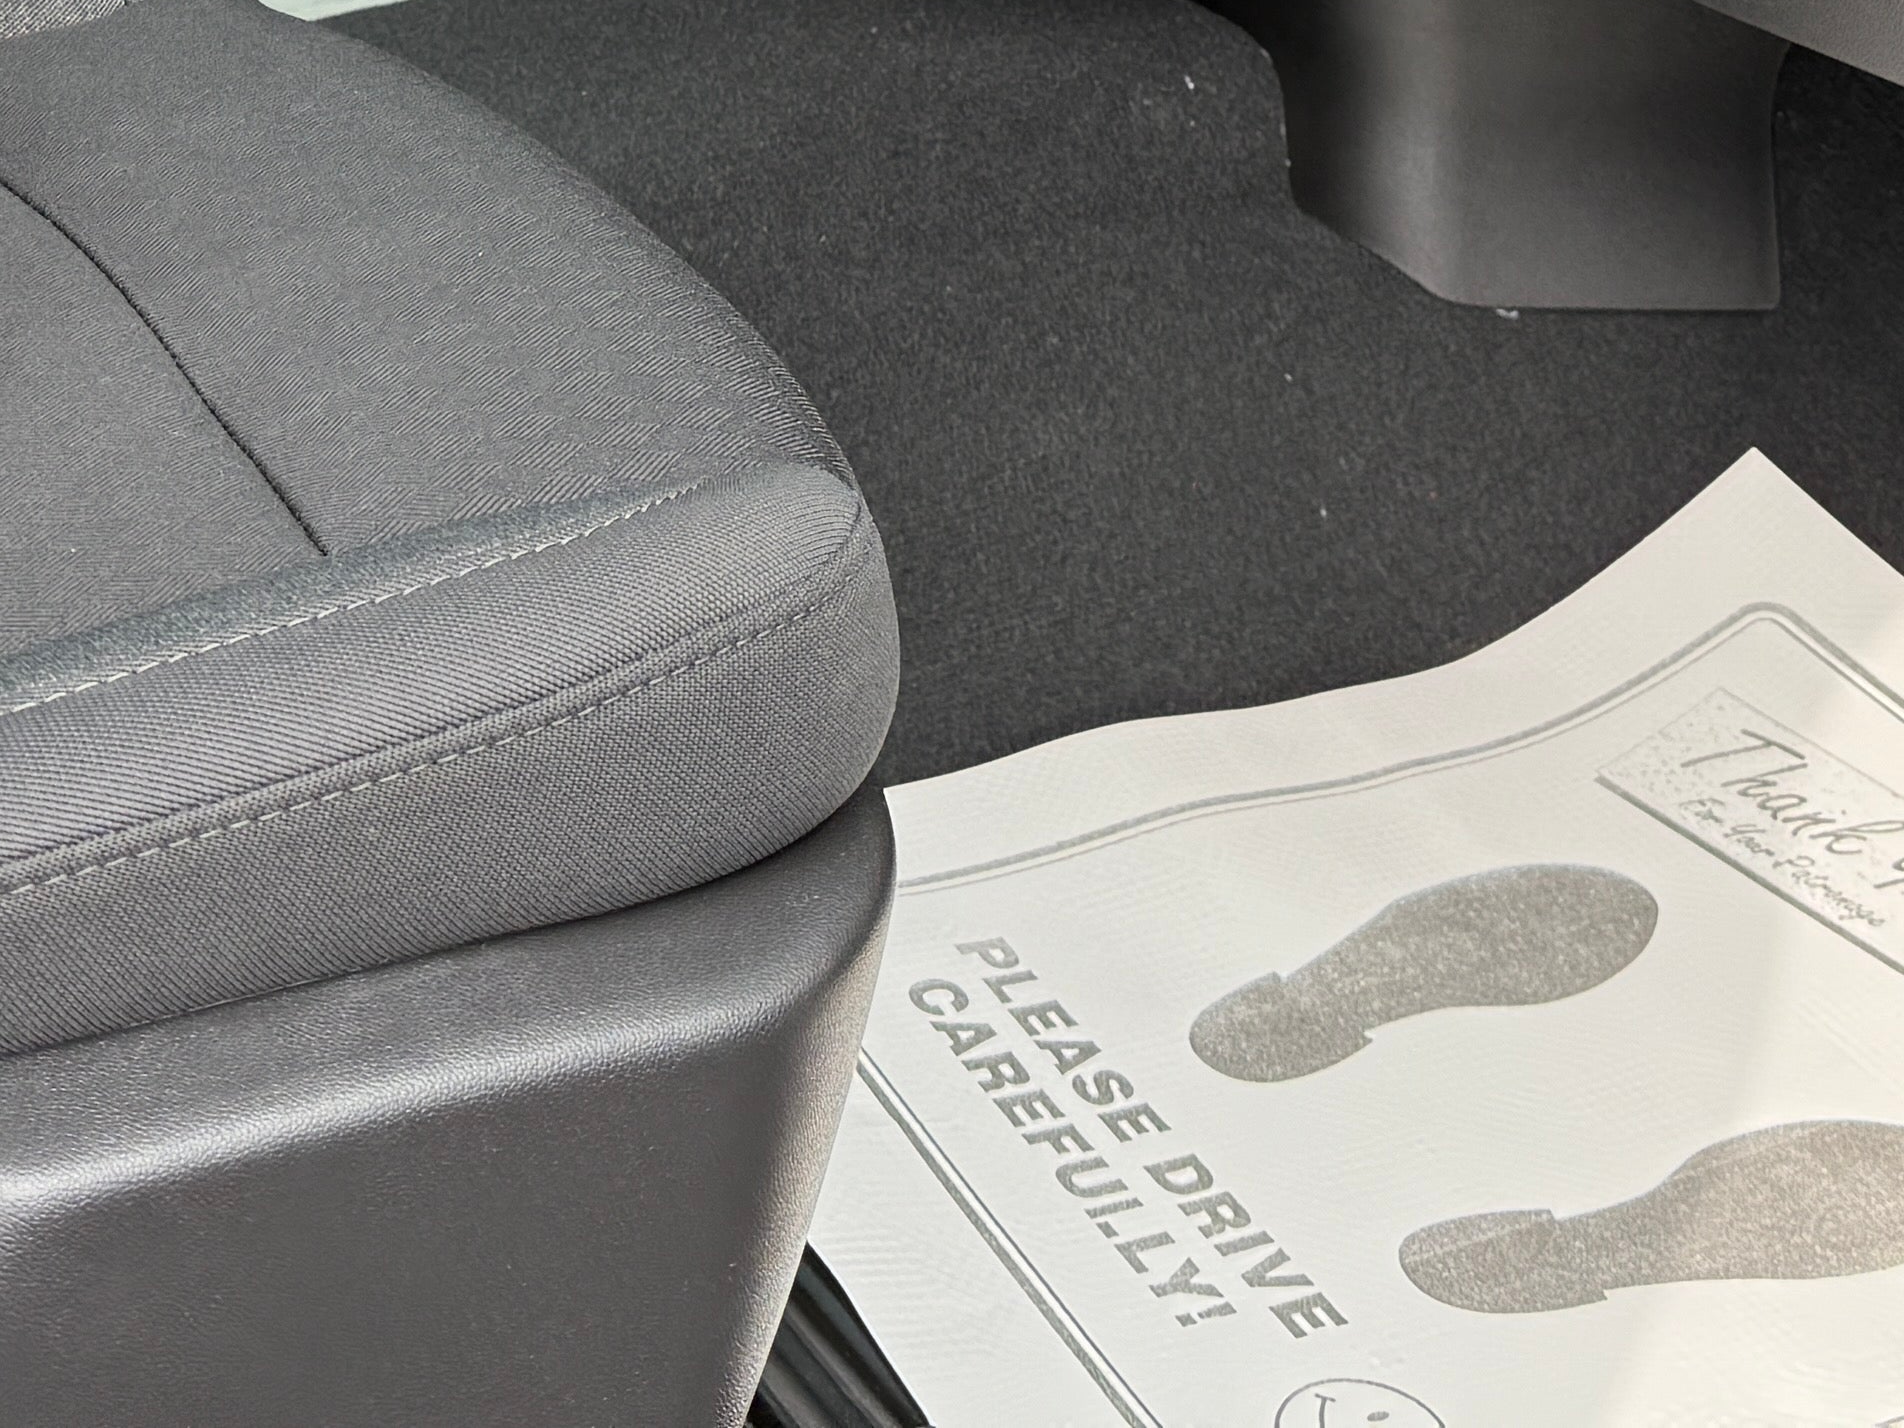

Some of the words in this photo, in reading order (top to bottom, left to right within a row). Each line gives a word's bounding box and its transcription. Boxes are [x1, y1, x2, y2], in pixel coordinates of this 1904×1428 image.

[1679, 797, 1723, 825] For
[1724, 822, 1775, 857] Your
[908, 977, 1237, 1328] CAREFULLY!
[953, 936, 1173, 1143] PLEASE
[1144, 1152, 1349, 1339] DRIVE
